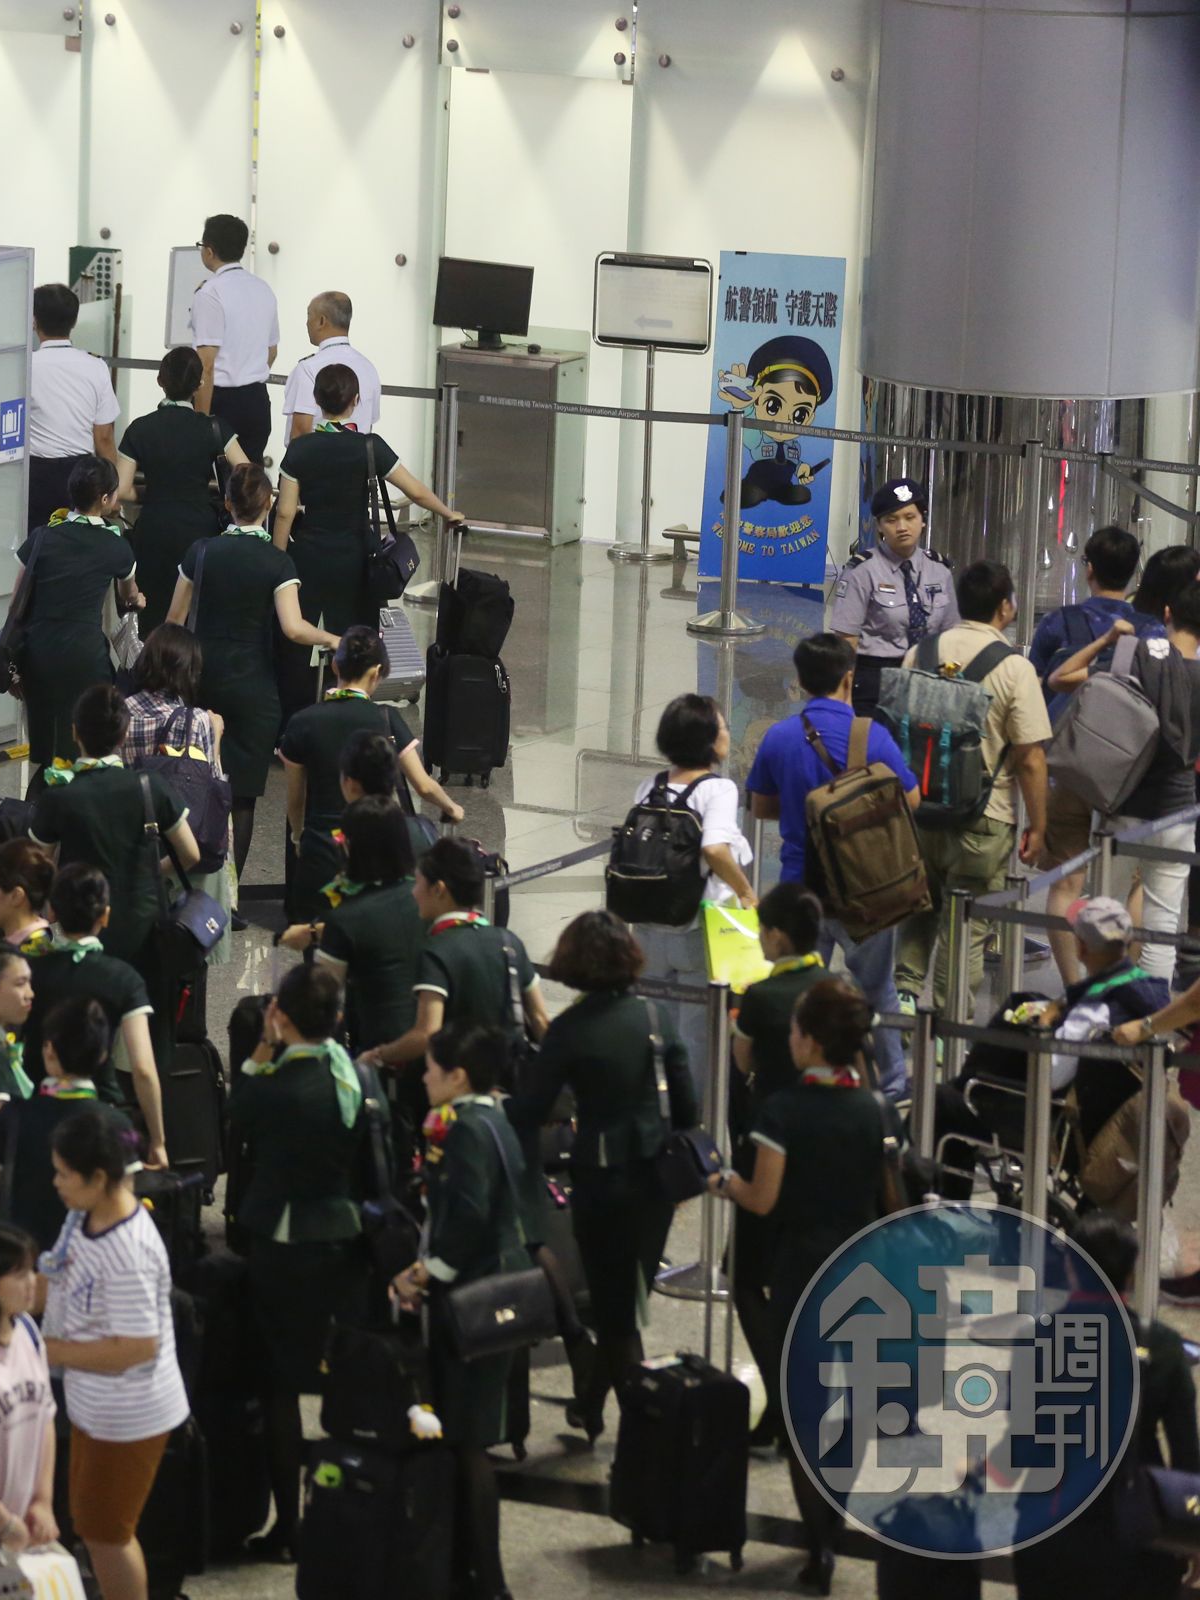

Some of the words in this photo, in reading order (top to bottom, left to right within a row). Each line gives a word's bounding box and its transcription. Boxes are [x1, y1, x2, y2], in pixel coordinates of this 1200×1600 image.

[724, 285, 778, 324] 航警領航
[785, 289, 838, 328] 守護天際
[532, 401, 552, 410] Taiwan
[553, 403, 579, 414] Taoyuan
[579, 405, 618, 417] International
[618, 409, 640, 419] Airport
[828, 431, 849, 440] Taiwan
[850, 433, 876, 444] Taoyuan
[877, 436, 916, 447] International
[916, 439, 939, 449] Airport
[1132, 459, 1172, 471] International
[1173, 464, 1195, 474] Airport
[761, 545, 775, 557] TO
[781, 529, 820, 555] TAIWAN
